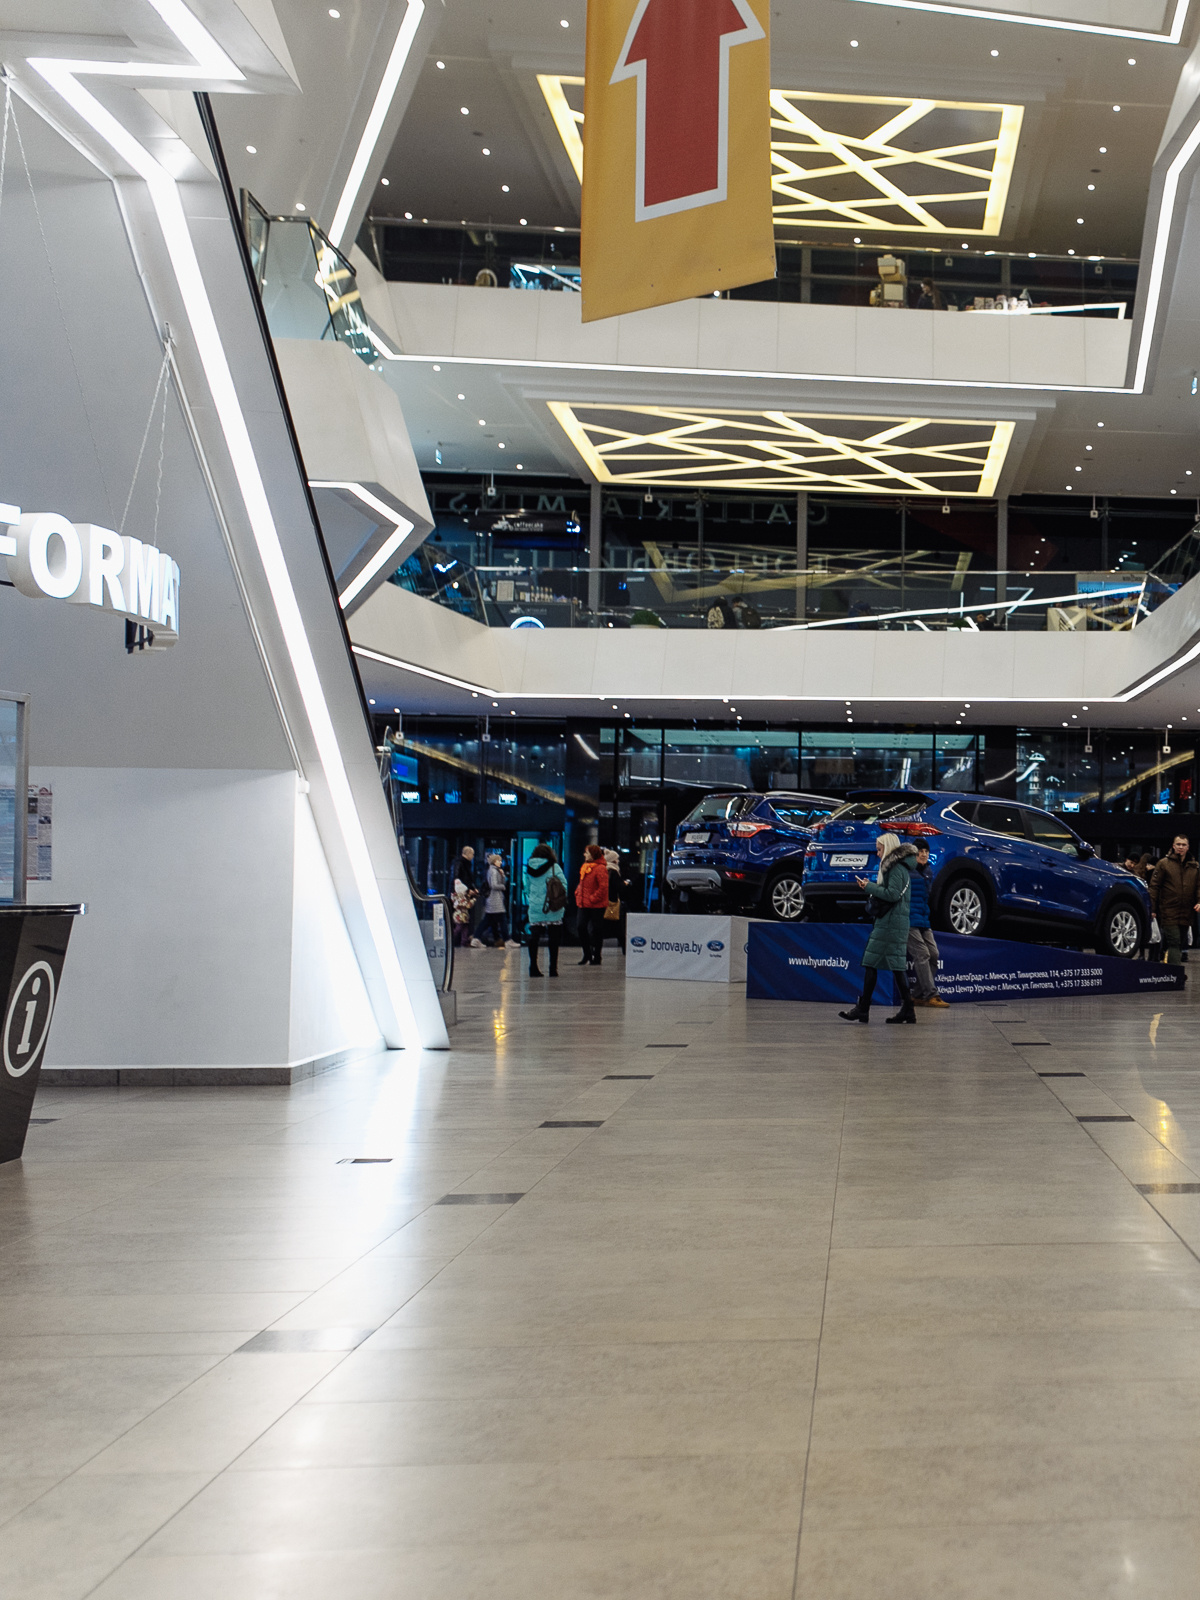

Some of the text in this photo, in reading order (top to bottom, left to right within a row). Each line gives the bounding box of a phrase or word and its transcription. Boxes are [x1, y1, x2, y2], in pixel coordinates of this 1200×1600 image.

[650, 938, 703, 956] borovaya.by
[788, 956, 850, 970] www.hyundai.by
[1060, 969, 1073, 977] +375
[1074, 968, 1080, 976] 17
[1081, 968, 1090, 976] 333
[1090, 968, 1103, 976] 5000
[1060, 980, 1073, 988] +375
[1074, 979, 1080, 987] 17
